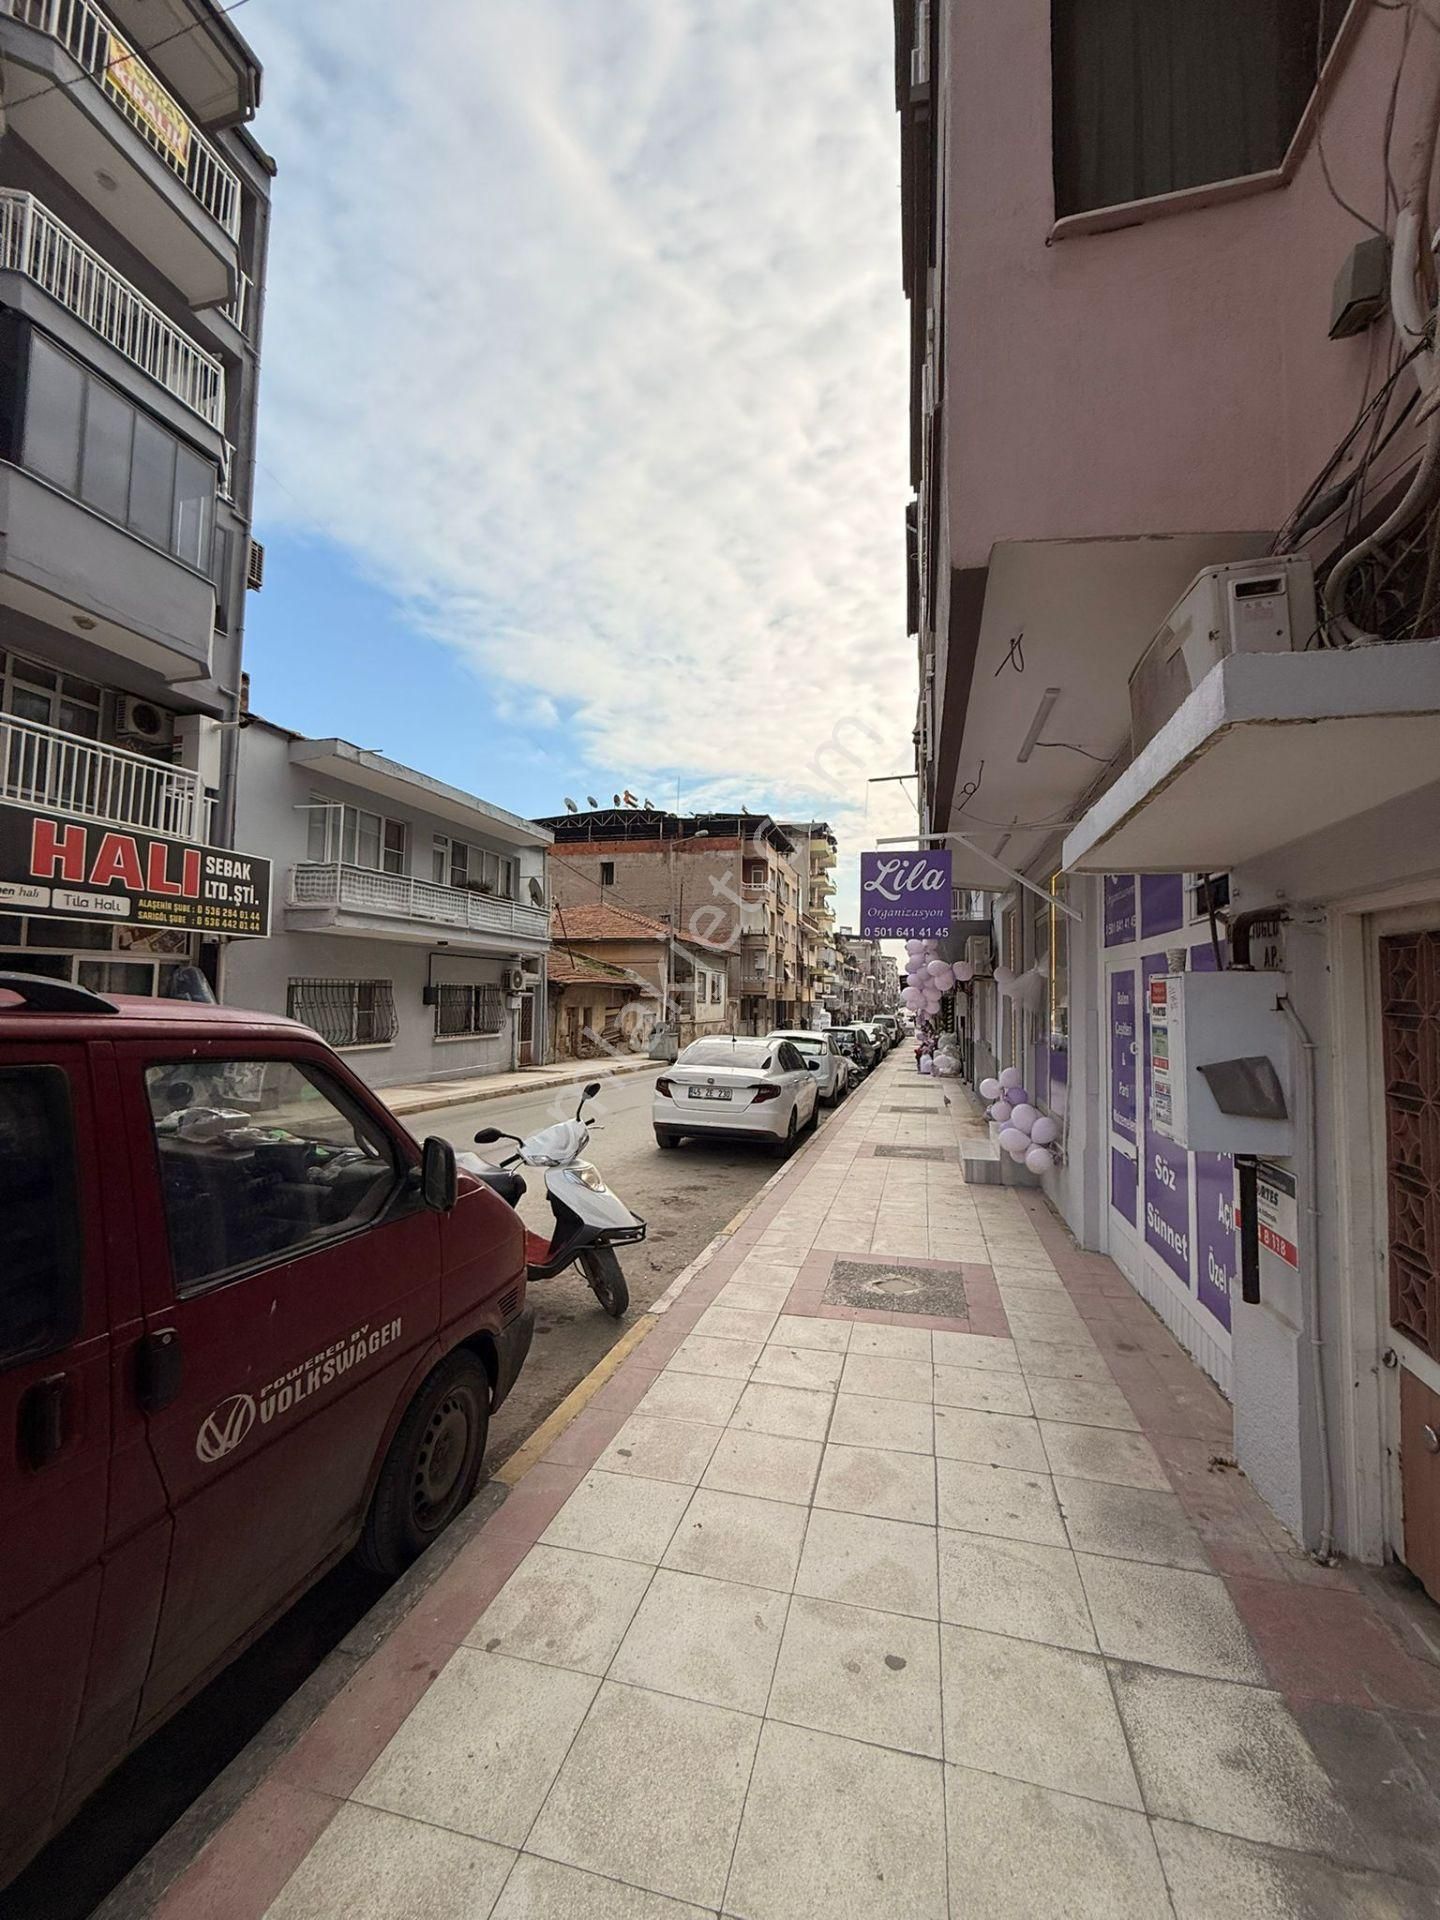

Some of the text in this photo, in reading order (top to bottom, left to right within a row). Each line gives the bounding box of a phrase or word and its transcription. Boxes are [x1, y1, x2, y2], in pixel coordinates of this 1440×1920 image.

[30, 818, 201, 898] HALI
[205, 856, 251, 881] SEBAK
[864, 859, 946, 901] Lila
[864, 927, 949, 937] 0 501 641 41 45
[868, 907, 944, 920] Organizasyon
[1155, 1154, 1176, 1191] Söz
[1147, 1202, 1188, 1262] Sünnet
[1208, 1245, 1227, 1294] Özel
[260, 1324, 369, 1398] POWERED BY
[260, 1317, 402, 1424] VOLKSWAGEN
